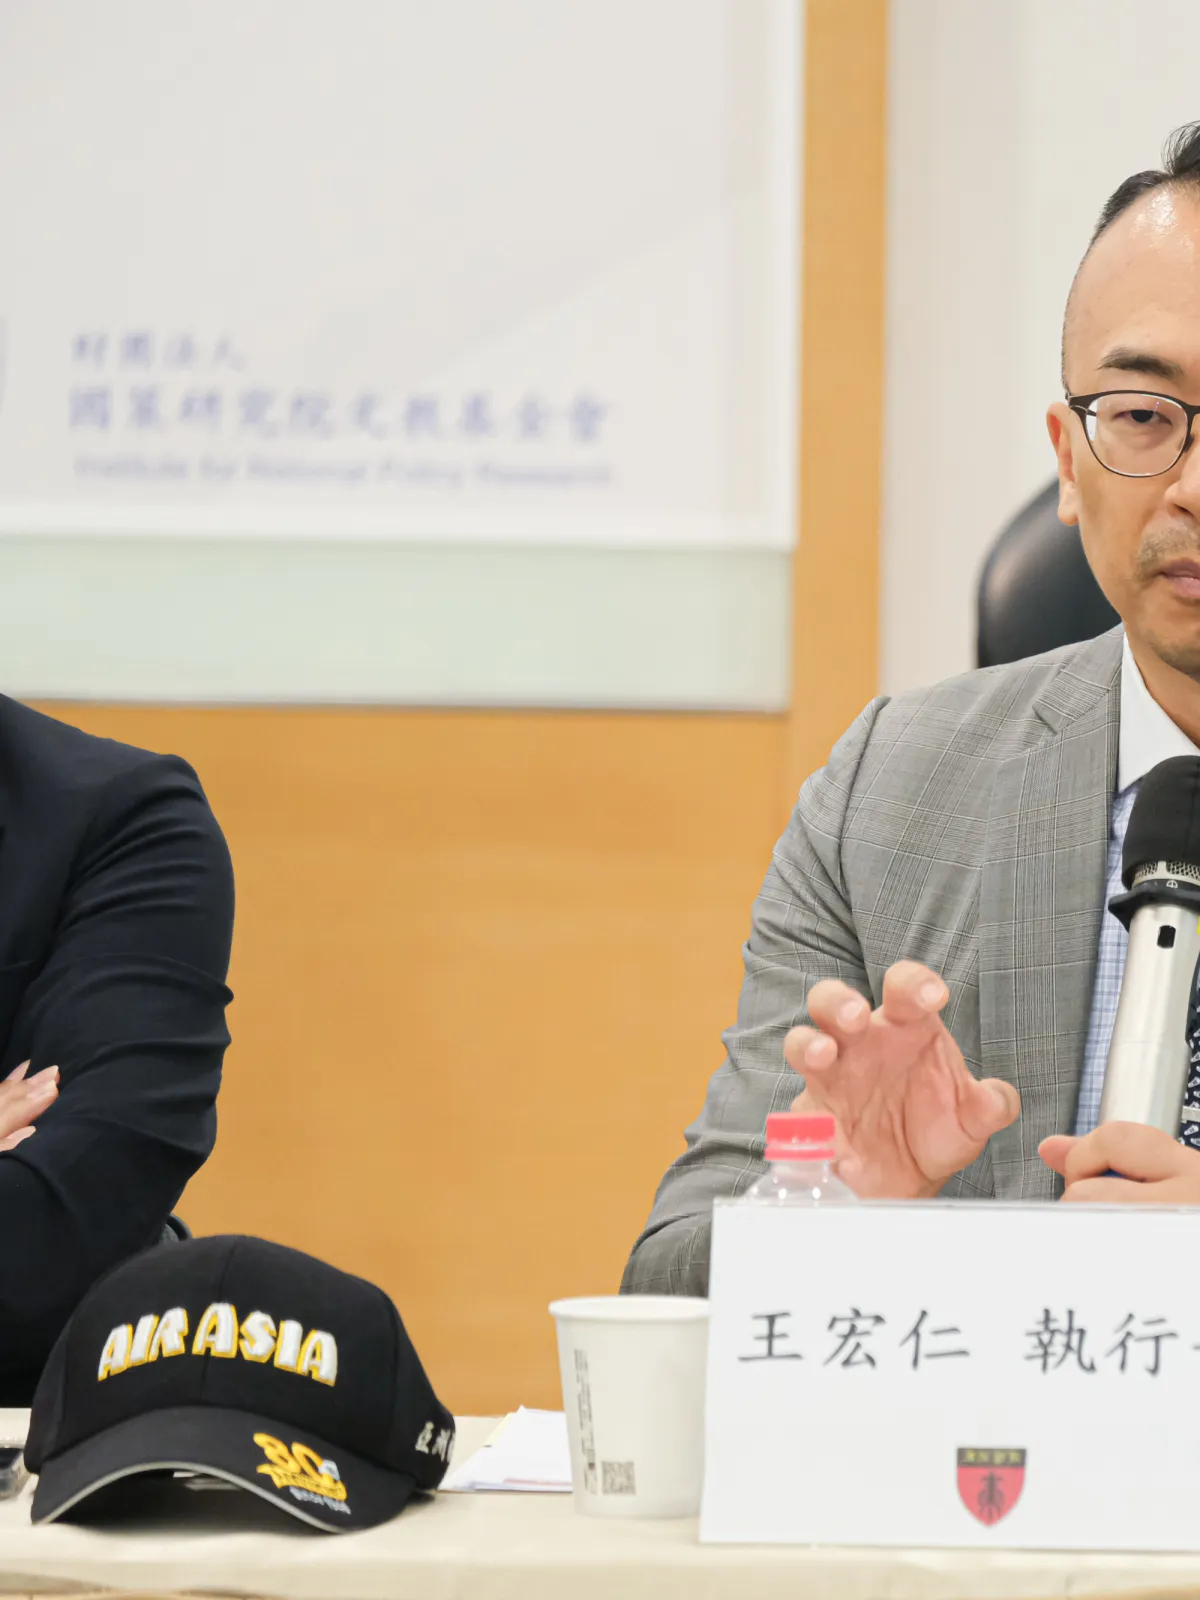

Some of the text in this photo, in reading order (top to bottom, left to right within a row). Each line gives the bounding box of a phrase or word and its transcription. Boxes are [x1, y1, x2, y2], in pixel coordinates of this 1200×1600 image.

[97, 1302, 338, 1386] AIR ASIA
[738, 1308, 970, 1369] 王宏仁
